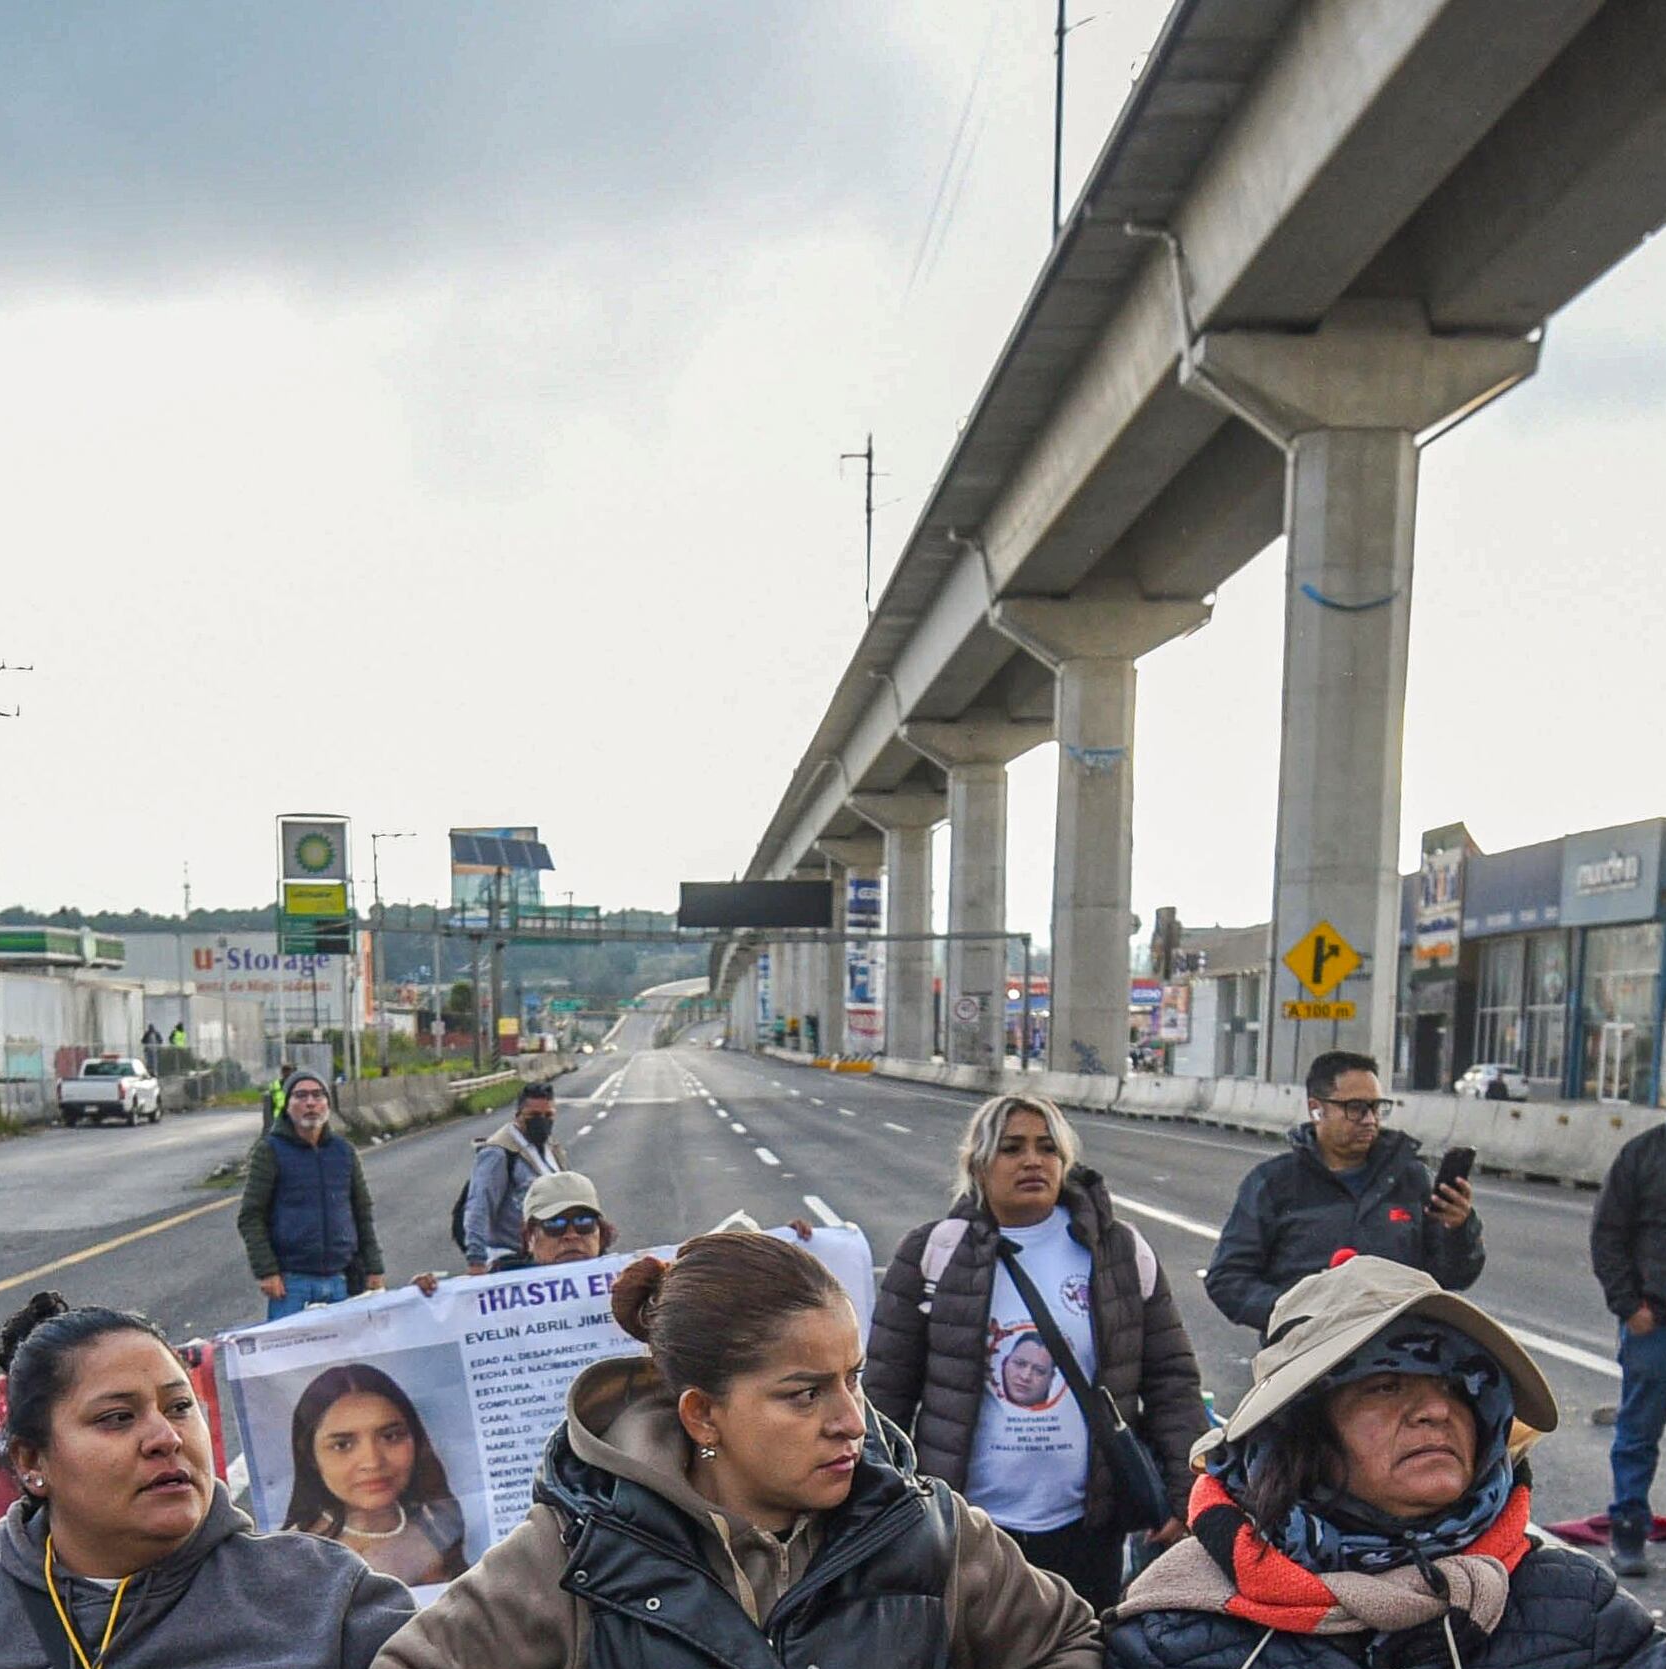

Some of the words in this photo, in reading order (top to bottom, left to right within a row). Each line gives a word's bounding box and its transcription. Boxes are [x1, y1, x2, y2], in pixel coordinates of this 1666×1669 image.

[1306, 1003, 1330, 1018] 100
[478, 1277, 580, 1315] ¡HASTA
[465, 1326, 520, 1345] EVELIN
[525, 1318, 573, 1335] ABRIL
[470, 1355, 501, 1368] EDAD
[503, 1353, 515, 1363] AL
[472, 1371, 508, 1382] FECHA
[510, 1367, 525, 1377] DE
